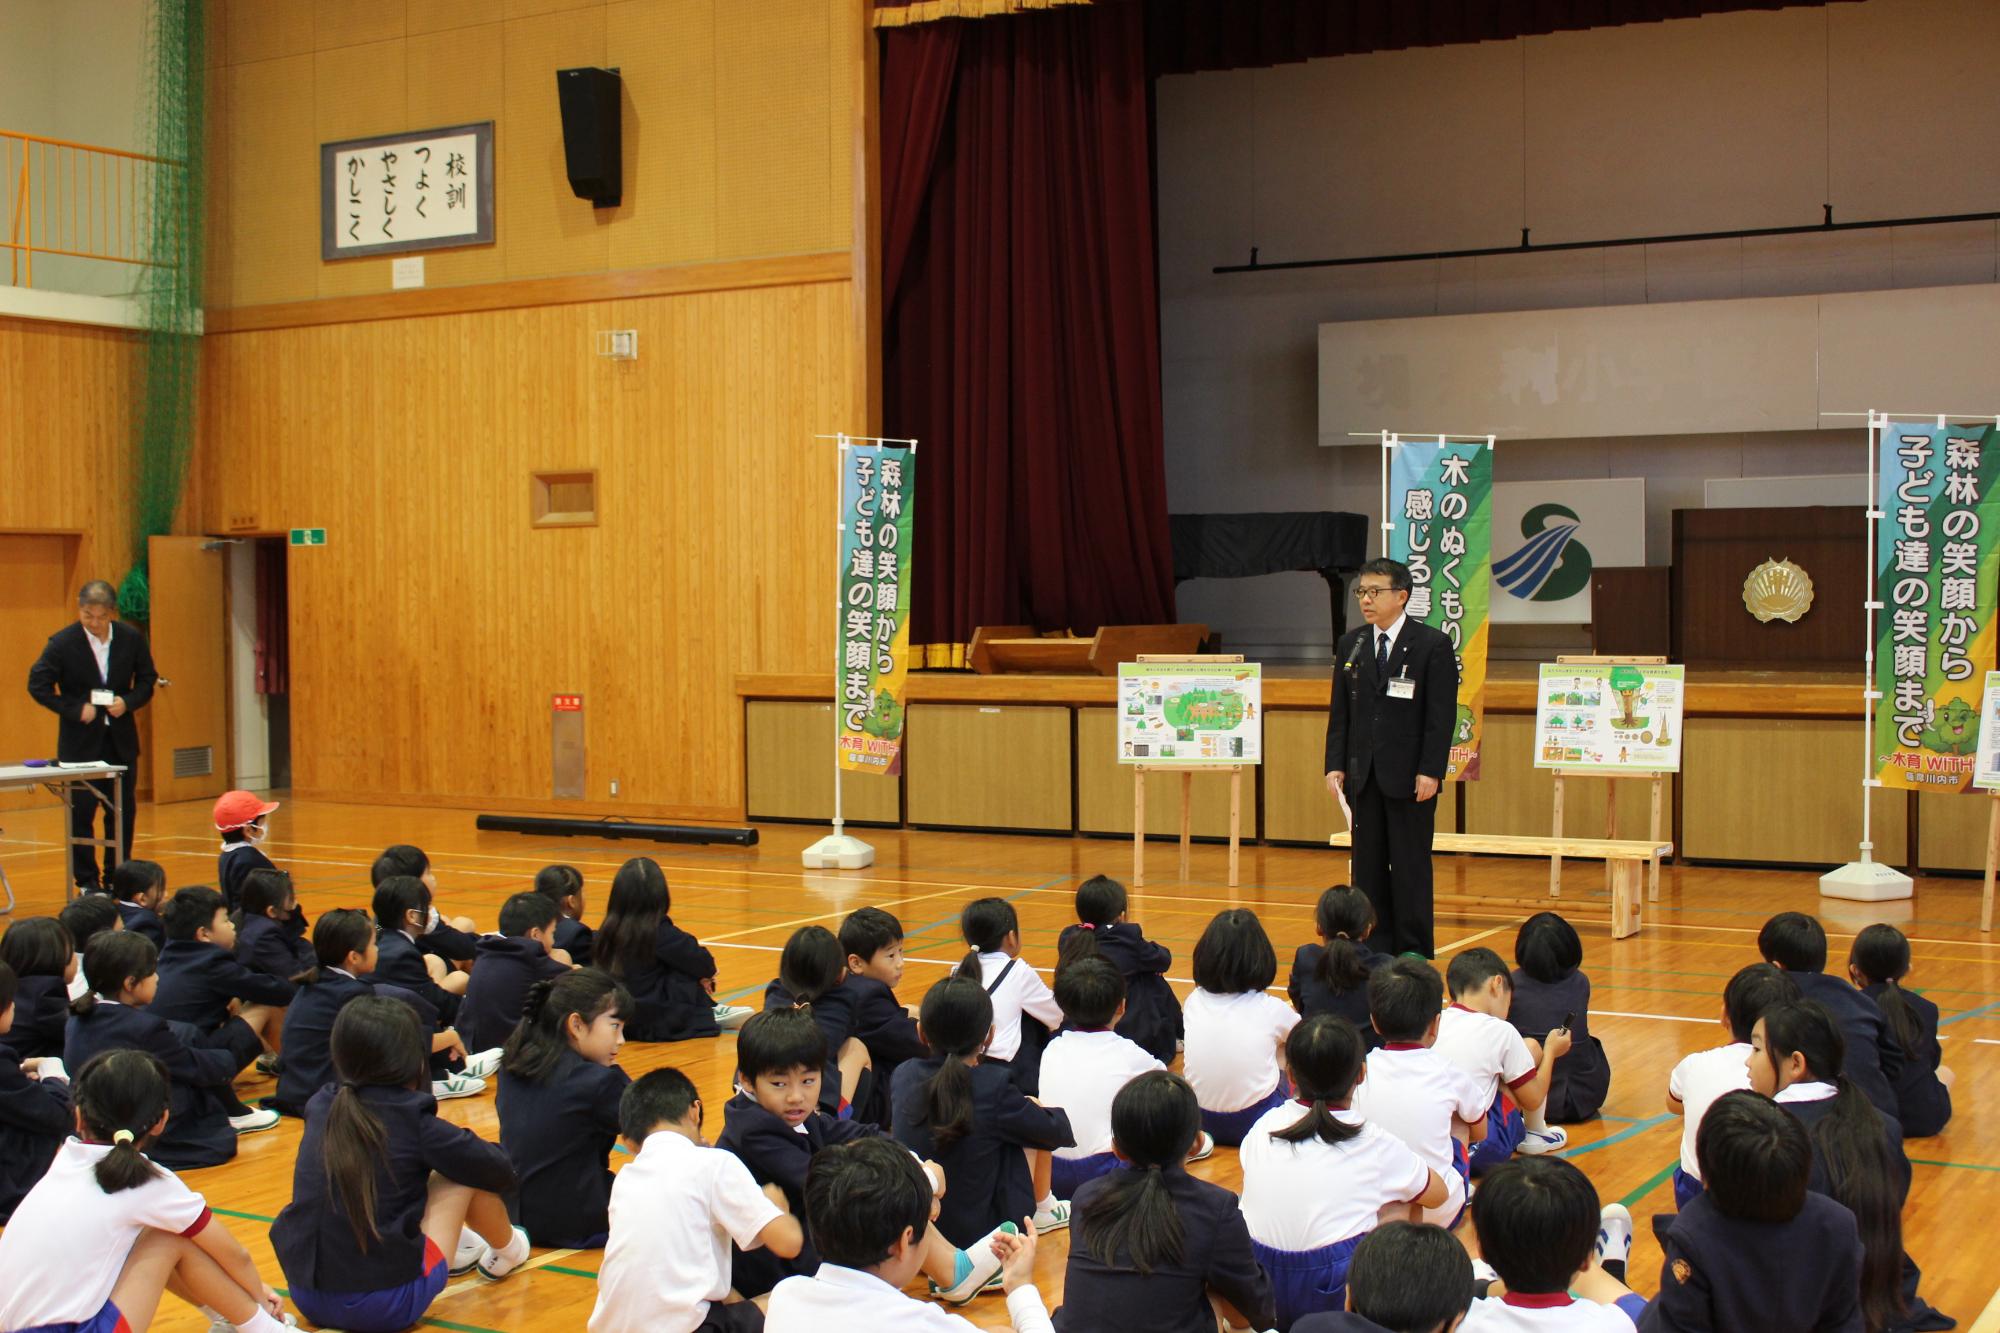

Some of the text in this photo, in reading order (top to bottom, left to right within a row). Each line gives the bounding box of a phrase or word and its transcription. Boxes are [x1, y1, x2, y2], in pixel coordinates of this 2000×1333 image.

[348, 155, 365, 241] かしこく
[381, 151, 398, 239] やさしく
[414, 146, 431, 218] つよく
[446, 152, 468, 209] 校訓
[843, 456, 875, 731] 子ども達の笑顔まで
[876, 458, 902, 674] 森林の笑顔から
[1404, 489, 1433, 624] 感じる暮
[1440, 455, 1470, 684] 木のぬくもり
[1892, 435, 1934, 748] 子ども達の笑顔まで
[1941, 437, 1980, 680] 森林の笑顔から
